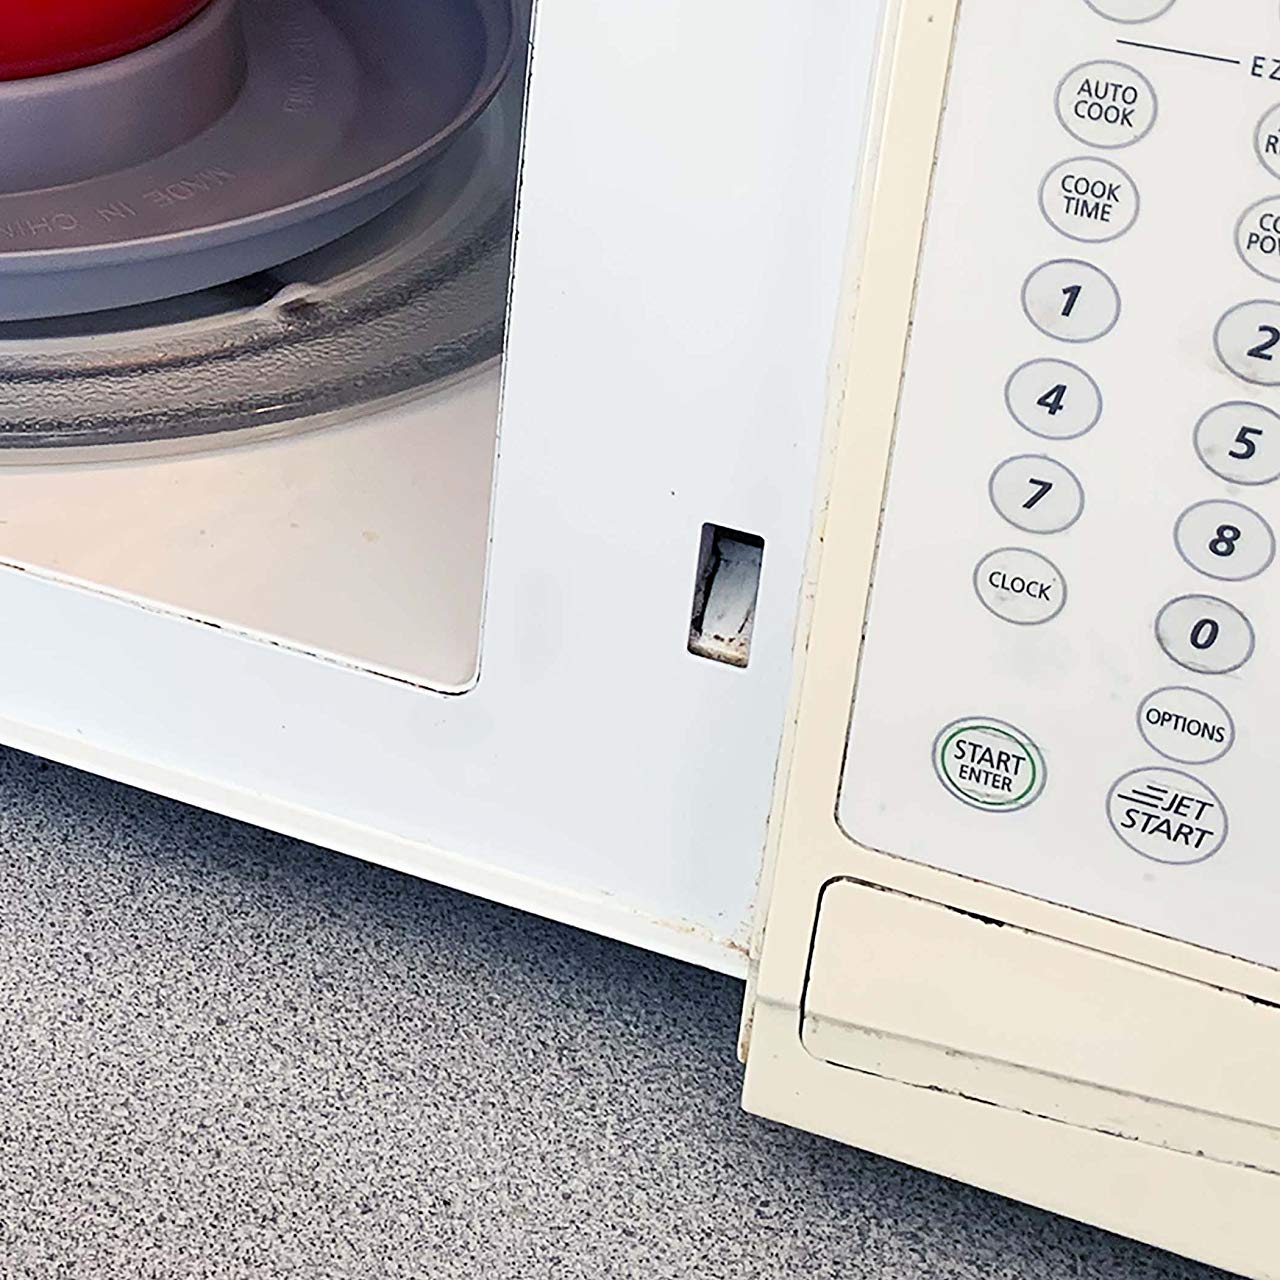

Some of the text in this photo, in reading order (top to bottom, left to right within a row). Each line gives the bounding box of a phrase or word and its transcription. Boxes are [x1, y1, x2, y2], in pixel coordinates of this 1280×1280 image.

[1077, 78, 1139, 105] AUTO
[1073, 99, 1135, 128] COOK
[1060, 174, 1122, 203] COOK
[94, 199, 138, 224] IN
[1063, 195, 1114, 223] TIME
[1061, 284, 1082, 318] 1
[1246, 325, 1280, 361] 2
[1036, 383, 1068, 416] 4
[1228, 425, 1263, 461] 5
[1021, 478, 1053, 510] 7
[1208, 524, 1241, 557] 8
[988, 570, 1052, 601] CLOCK
[1189, 618, 1220, 650] 0
[1145, 707, 1226, 744] OPTIONS
[953, 739, 1026, 777] START
[958, 764, 1013, 793] ENTER
[1161, 792, 1214, 821] JET
[1120, 808, 1214, 849] START
